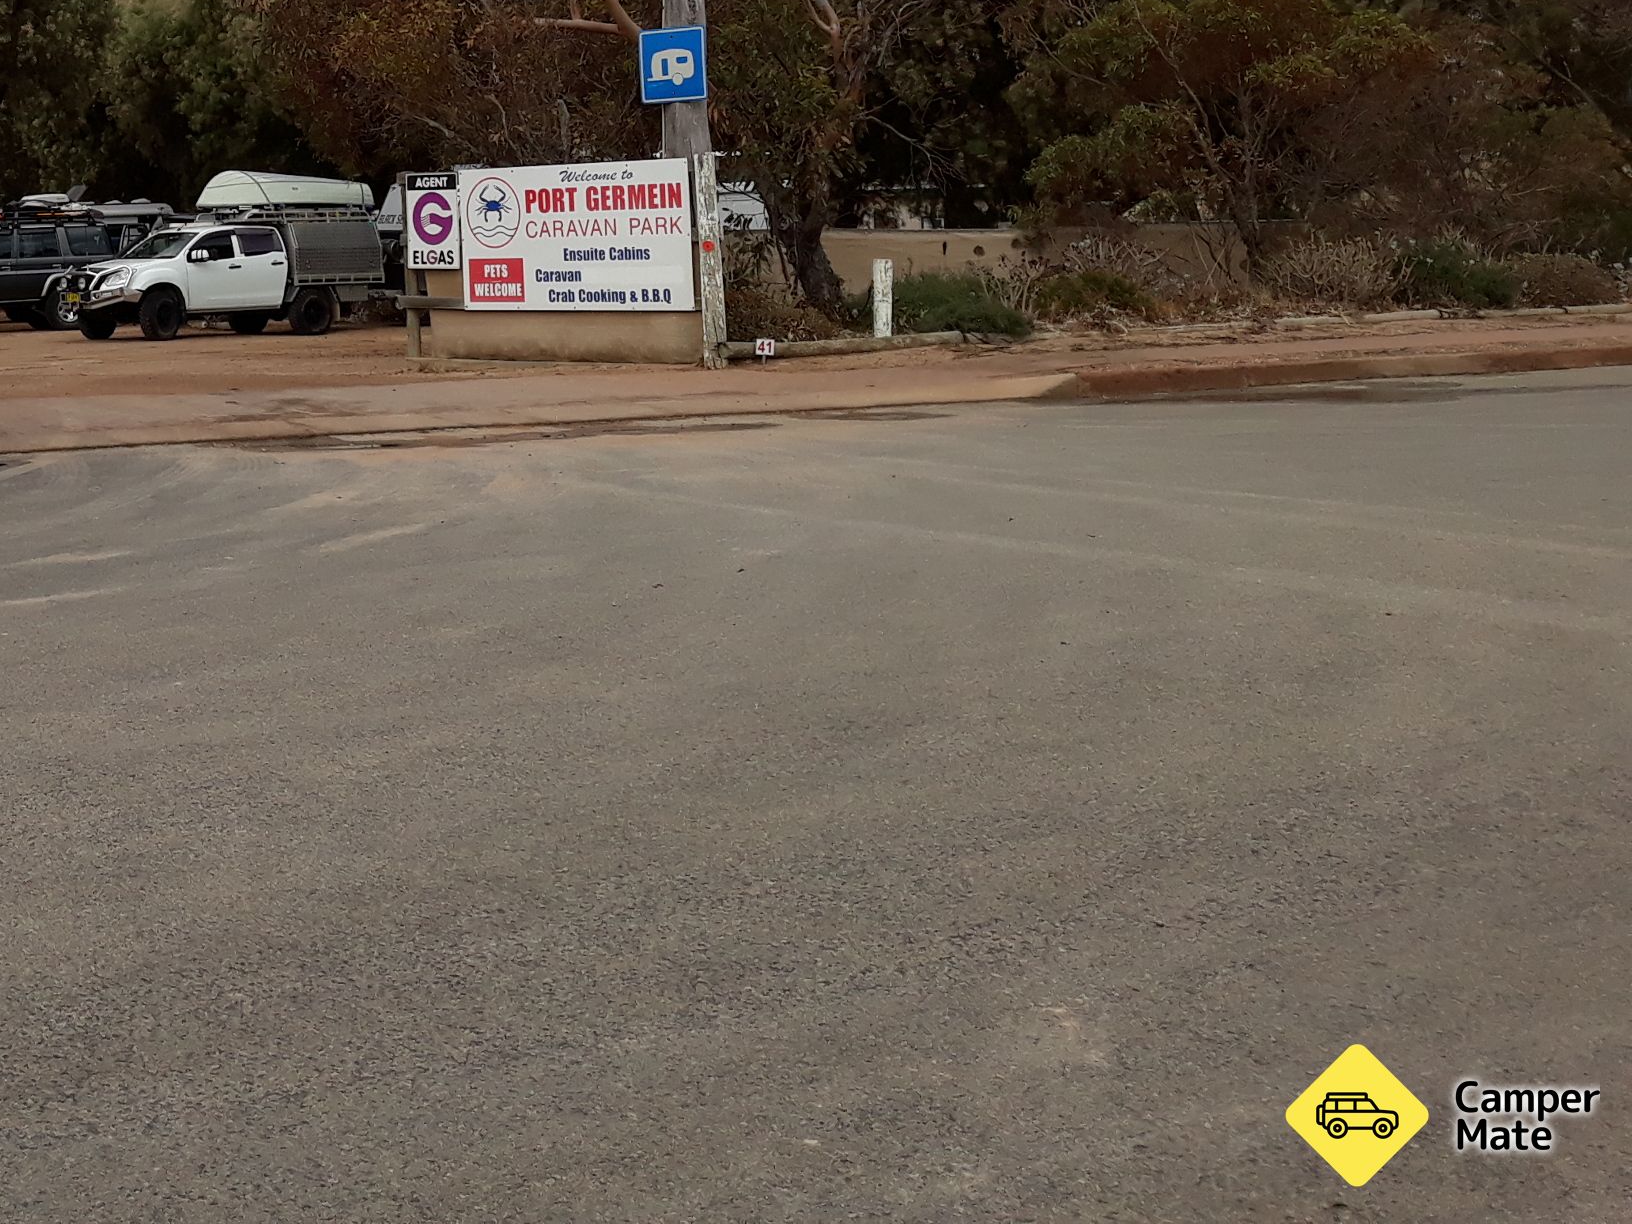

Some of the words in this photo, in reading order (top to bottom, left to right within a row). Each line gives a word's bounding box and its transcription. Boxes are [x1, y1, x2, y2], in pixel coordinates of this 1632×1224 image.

[415, 177, 448, 188] AGENT
[559, 169, 617, 183] Welcome
[621, 168, 633, 180] to
[524, 187, 578, 214] PORT
[585, 182, 683, 212] GERMEIN
[525, 218, 617, 239] CARAVAN
[629, 216, 683, 236] PARK
[413, 250, 455, 265] ELGAS
[563, 247, 606, 261] Ensuite
[609, 246, 651, 261] Cabins
[484, 264, 508, 278] PETS
[535, 268, 582, 283] Caravan
[474, 283, 523, 297] WELCOME
[548, 289, 575, 303] Crab
[578, 289, 627, 304] Cooking
[630, 291, 638, 302] &
[641, 288, 672, 304] B.B.Q
[758, 340, 772, 354] 41
